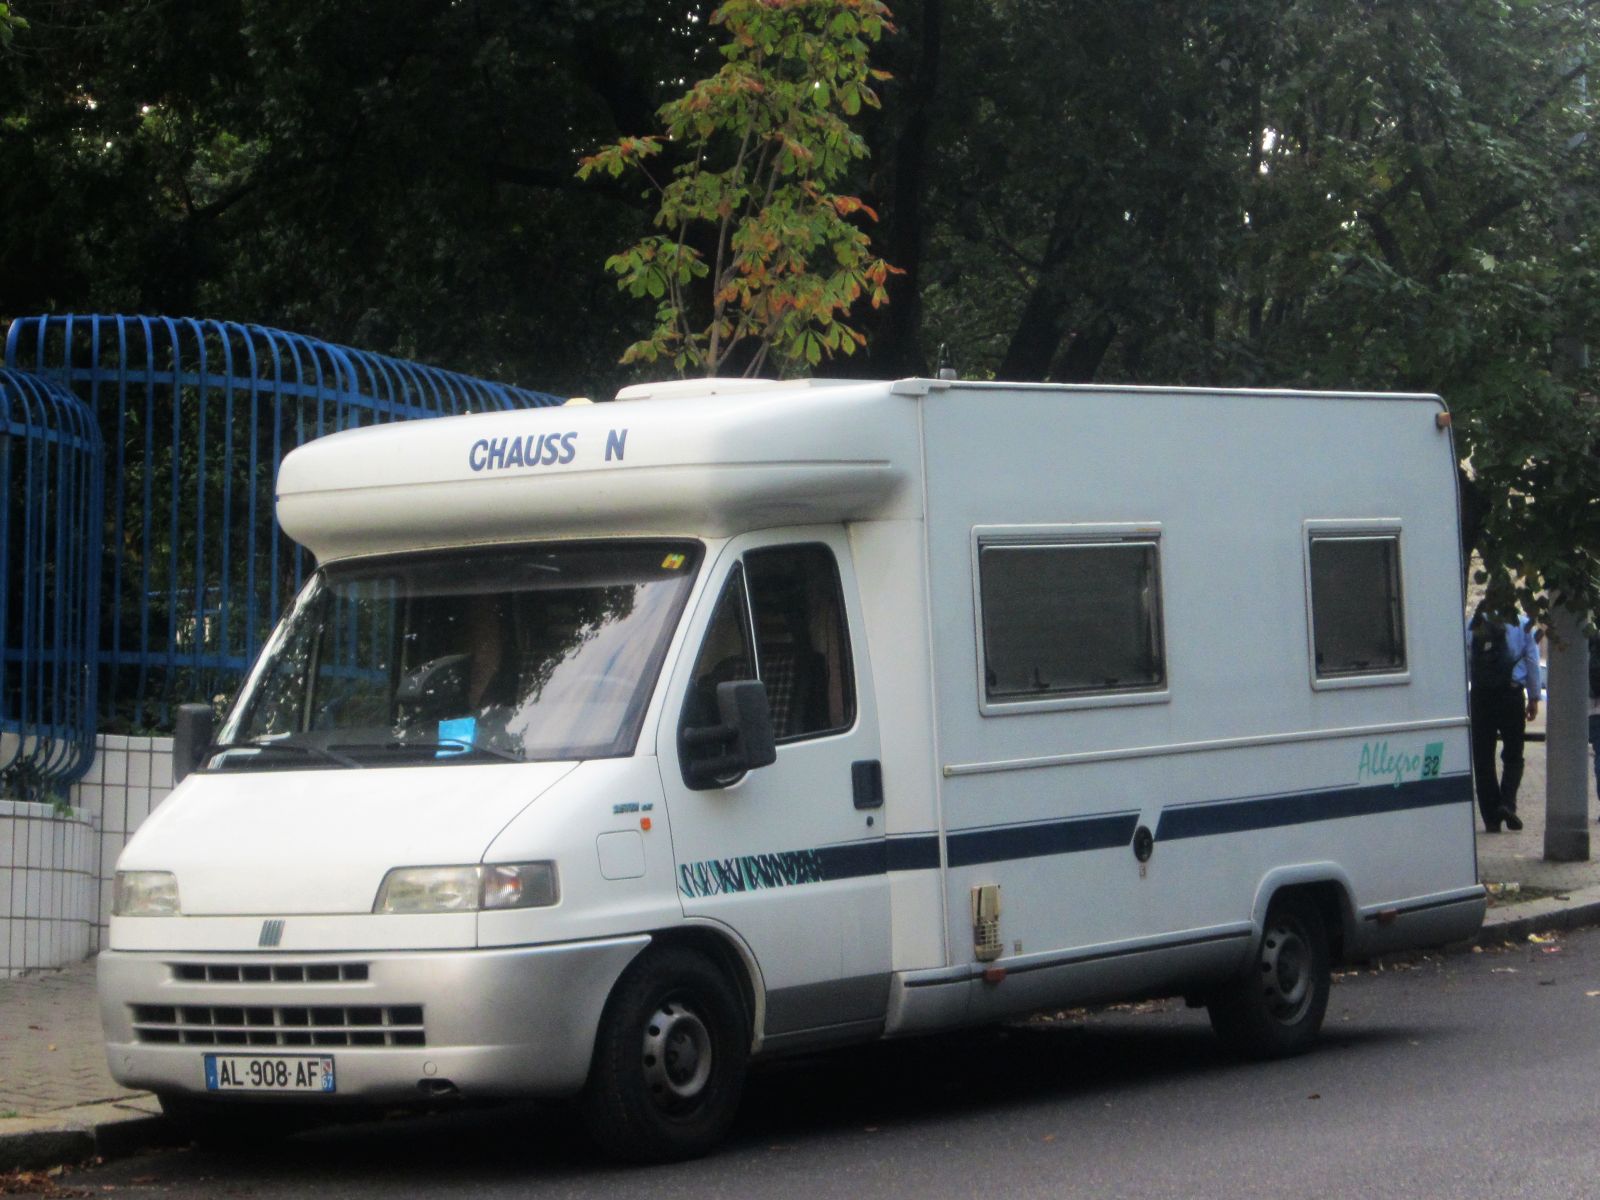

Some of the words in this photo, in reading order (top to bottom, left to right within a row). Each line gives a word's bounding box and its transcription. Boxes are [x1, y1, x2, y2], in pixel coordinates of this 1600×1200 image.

[1358, 740, 1420, 788] Allegro
[1423, 755, 1440, 776] 32
[322, 1075, 333, 1088] 67
